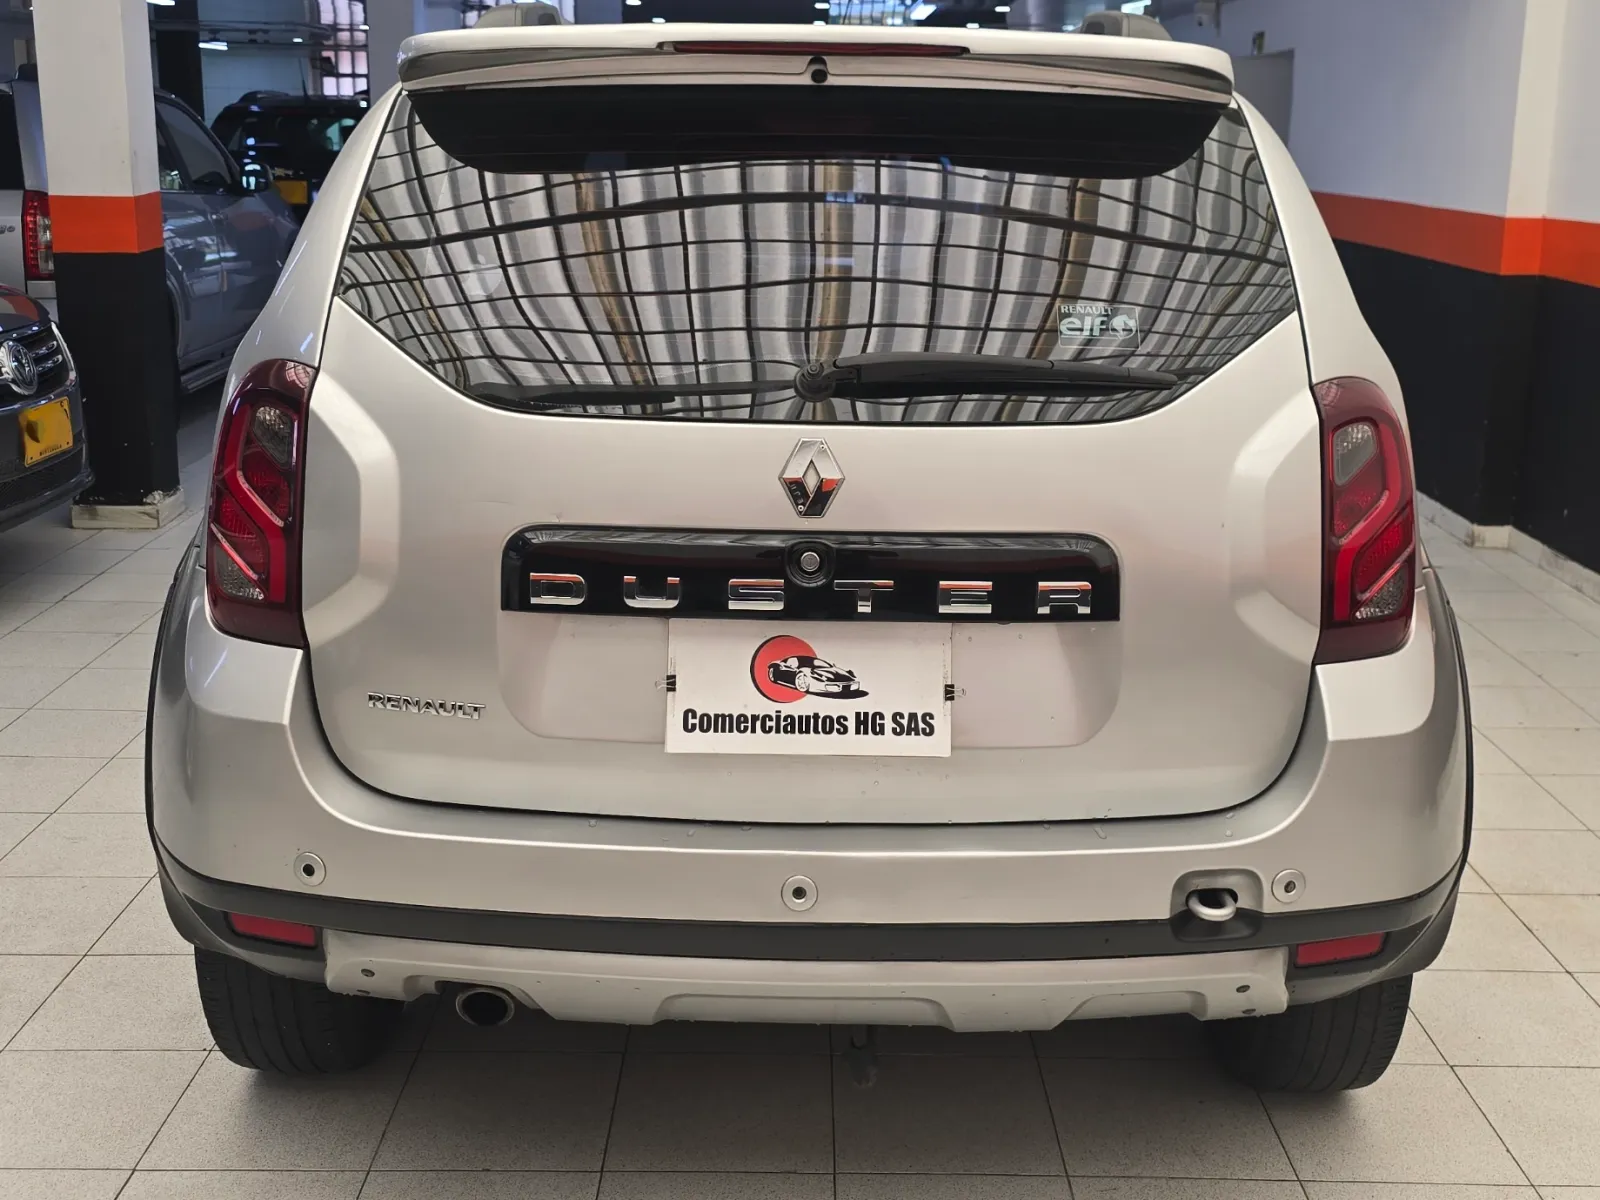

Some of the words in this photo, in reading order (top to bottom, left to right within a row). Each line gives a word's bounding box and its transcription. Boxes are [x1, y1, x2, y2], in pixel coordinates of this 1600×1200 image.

[1060, 305, 1114, 315] RENAULT
[1060, 316, 1108, 336] elf
[529, 572, 1092, 614] DUSTER
[367, 691, 486, 720] RENAULT
[682, 708, 849, 736] Comerciautos
[854, 711, 885, 736] HG
[891, 711, 936, 737] SAS
